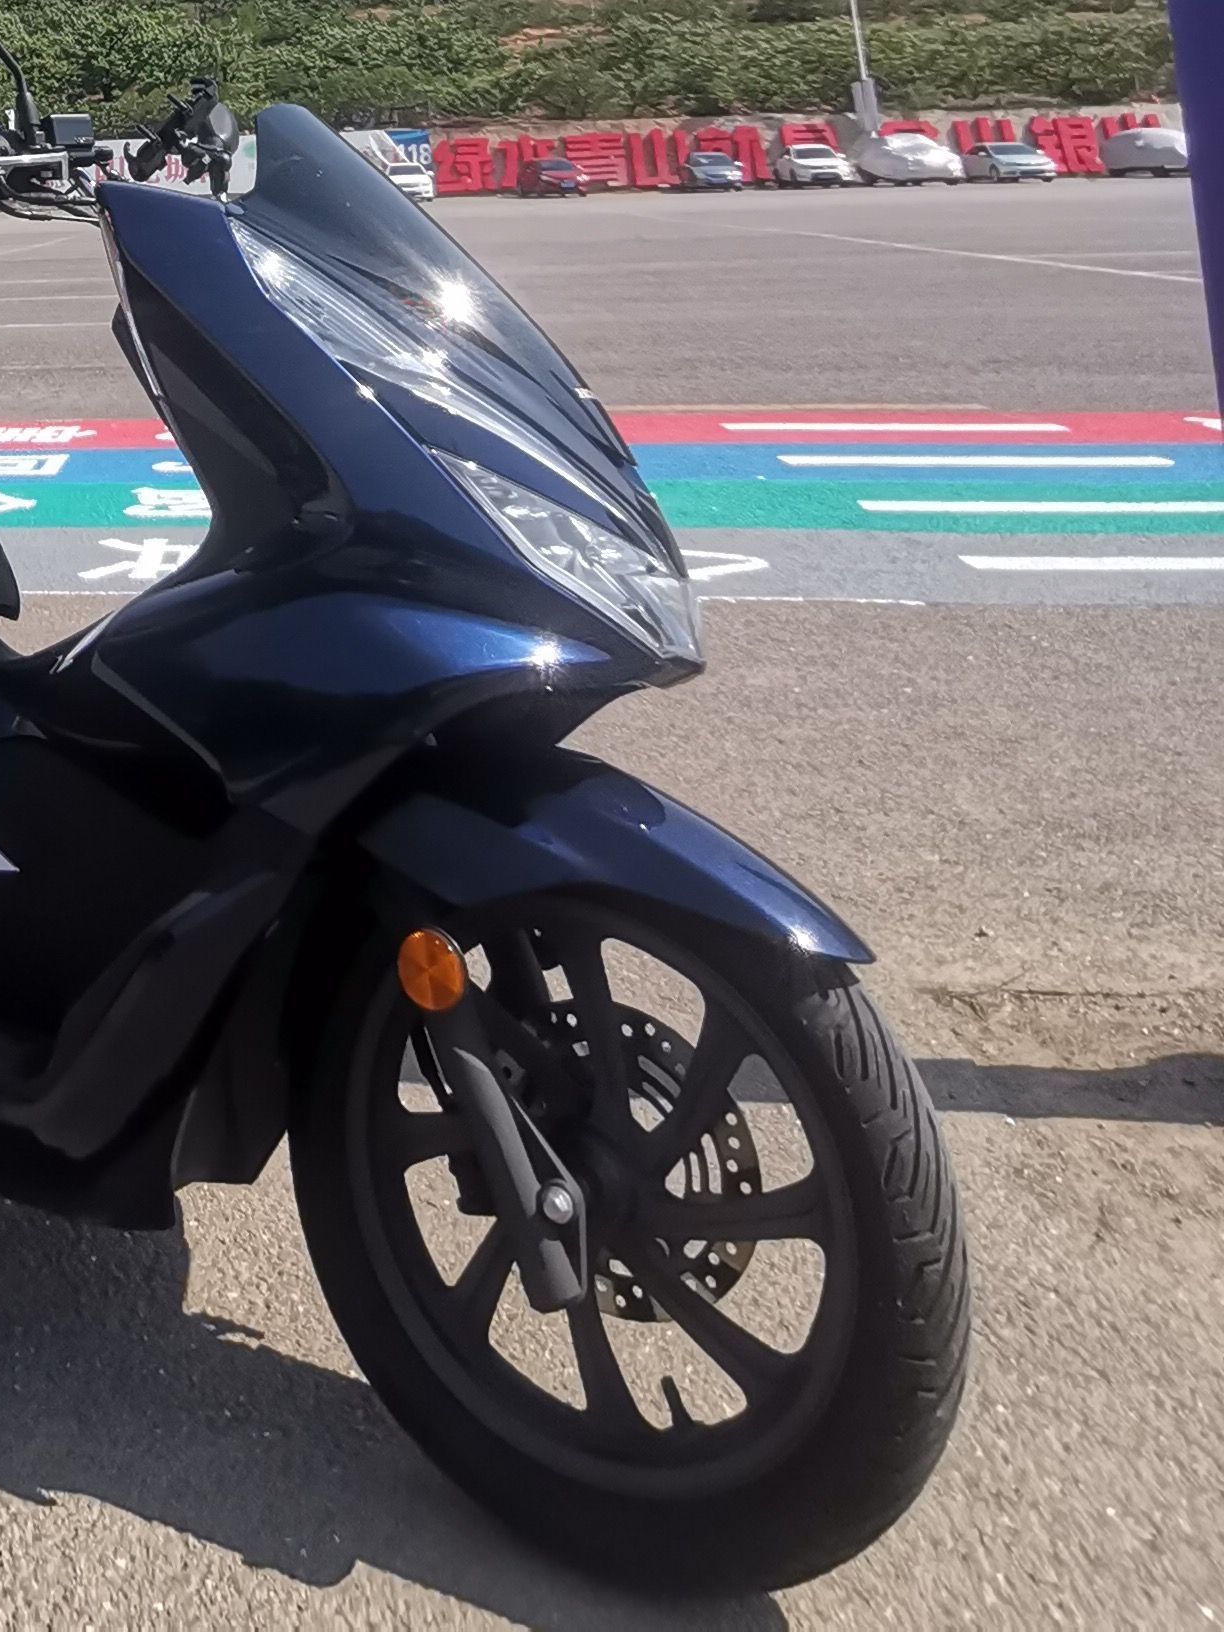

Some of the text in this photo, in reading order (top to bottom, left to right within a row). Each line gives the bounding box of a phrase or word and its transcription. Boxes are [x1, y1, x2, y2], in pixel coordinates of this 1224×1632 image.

[433, 114, 1162, 192] 绿水青山就山银
